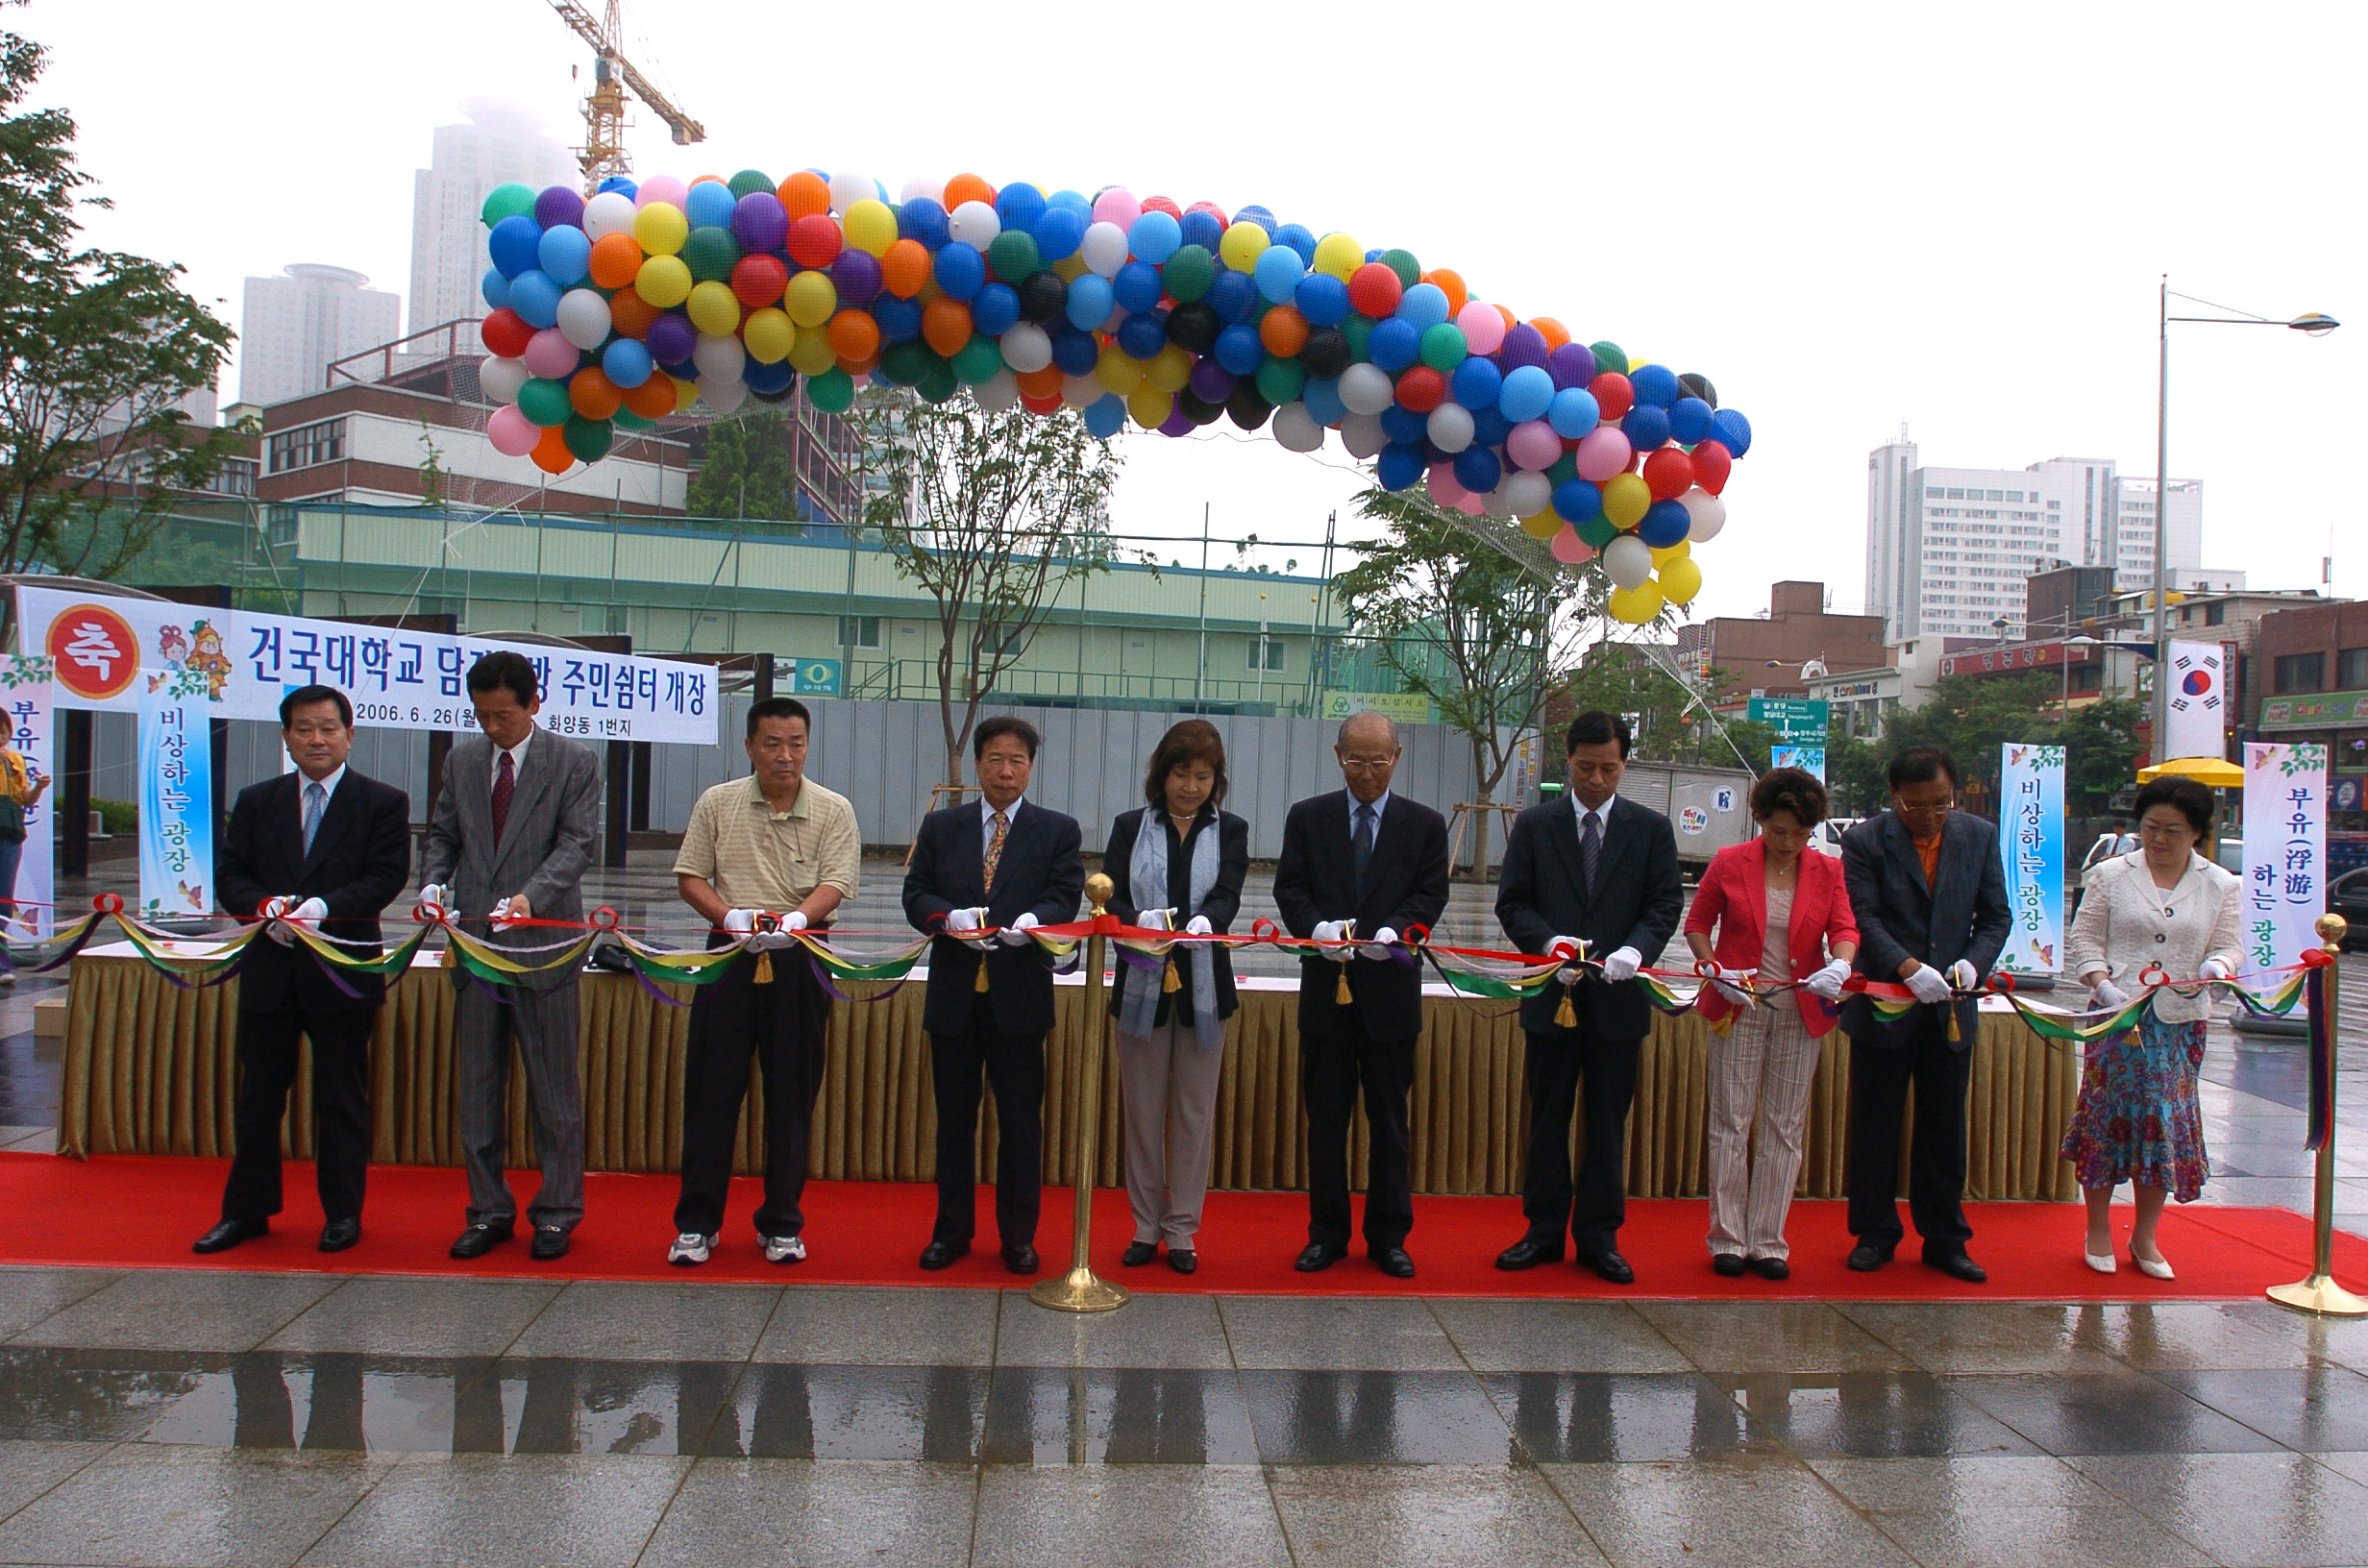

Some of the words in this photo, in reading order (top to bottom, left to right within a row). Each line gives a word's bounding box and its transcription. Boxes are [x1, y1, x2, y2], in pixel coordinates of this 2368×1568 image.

[64, 622, 121, 681] 축
[249, 626, 424, 692] 건국대학교
[437, 647, 552, 703] 담방
[562, 659, 656, 713] 주민쉼터
[666, 671, 706, 716] 개장
[357, 703, 404, 721] 2006.
[433, 708, 481, 728] 26(월
[549, 715, 590, 734] 화양동
[599, 719, 631, 736] 1번지
[160, 708, 190, 811] 비상하는
[162, 821, 191, 873] 광장
[2019, 778, 2046, 873] 비상하는
[2018, 884, 2044, 931] 광장
[2251, 865, 2278, 911] 하는
[2250, 919, 2277, 967] 광장
